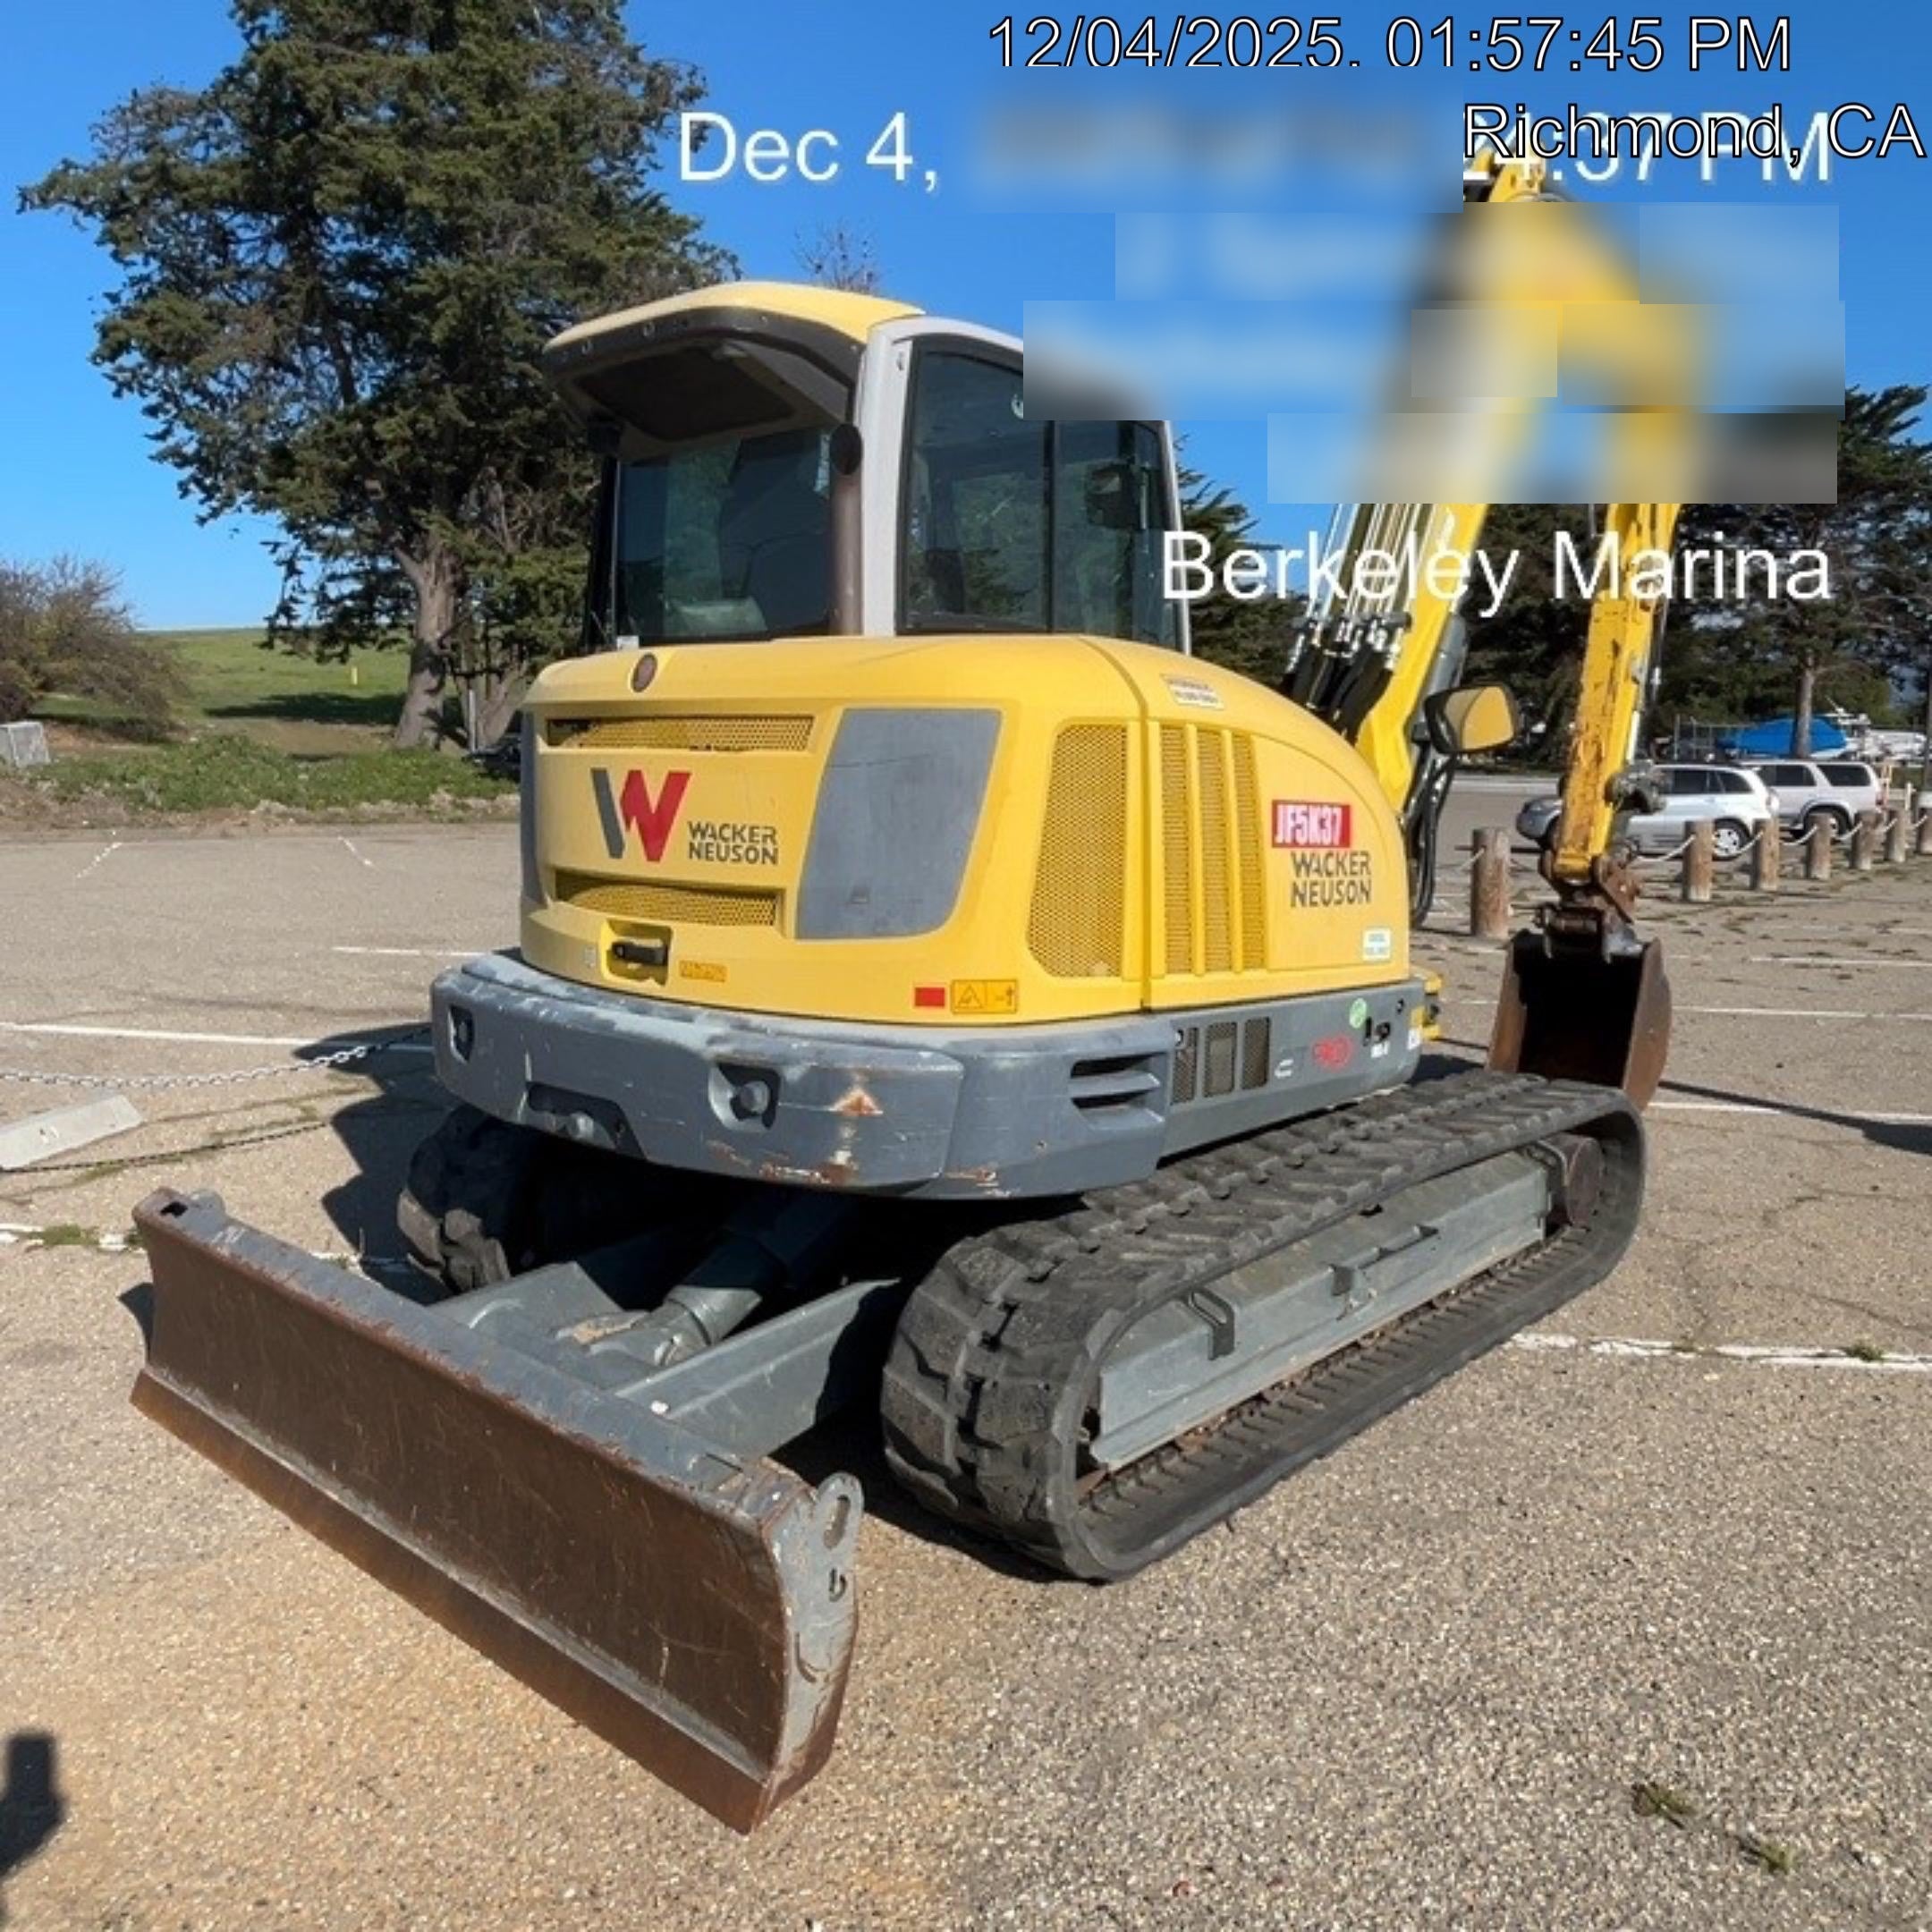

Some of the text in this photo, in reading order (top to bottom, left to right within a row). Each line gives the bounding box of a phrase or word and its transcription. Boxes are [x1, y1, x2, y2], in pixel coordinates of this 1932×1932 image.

[688, 821, 777, 845] WACKER
[689, 843, 779, 865] NEUSON
[1291, 852, 1371, 878] WACKER
[1291, 880, 1372, 908] NEUSON
